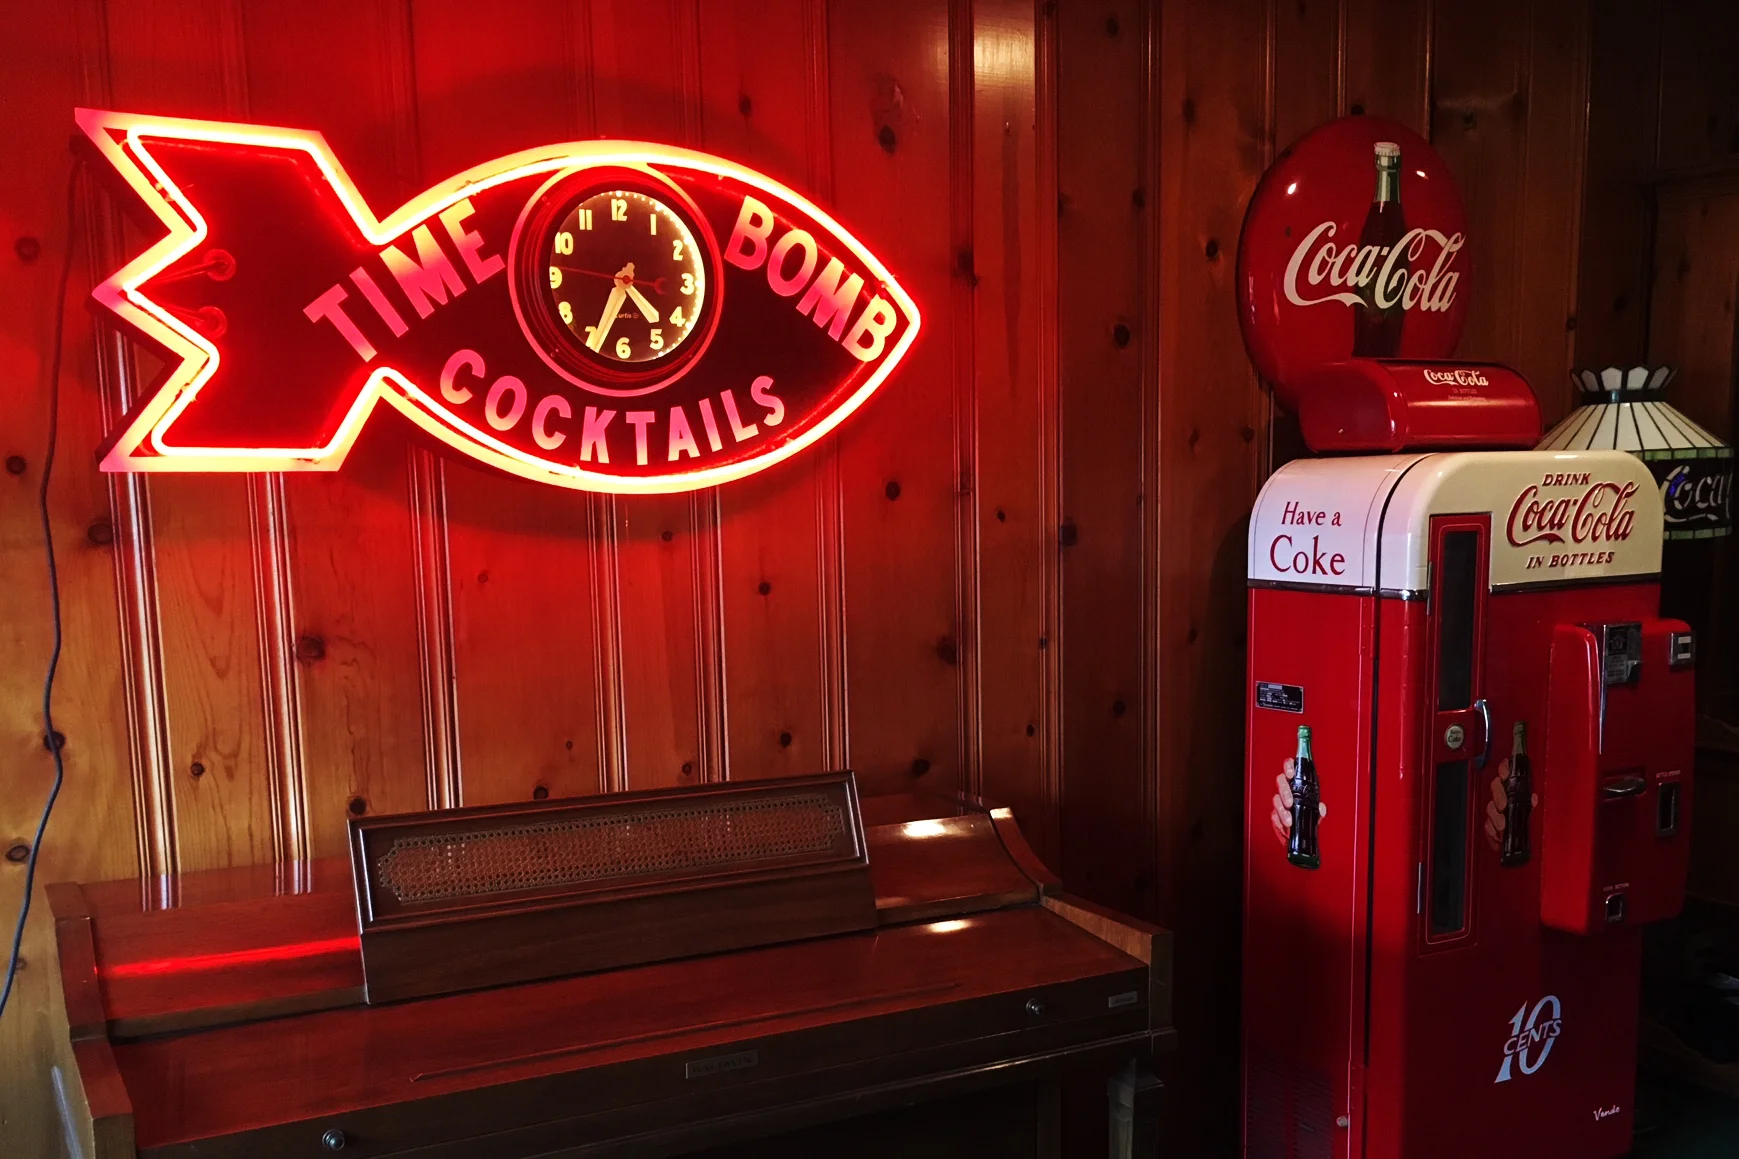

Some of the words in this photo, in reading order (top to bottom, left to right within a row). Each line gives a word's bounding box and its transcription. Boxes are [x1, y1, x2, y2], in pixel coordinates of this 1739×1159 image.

[578, 208, 593, 231] 11
[611, 198, 628, 221] 12
[650, 213, 657, 236] 1
[554, 231, 574, 255] 10
[672, 239, 683, 261] 2
[549, 266, 563, 289] 9
[1283, 220, 1467, 313] Coca-Cola
[304, 199, 507, 363] TIME
[724, 194, 898, 362] BOMB
[680, 272, 695, 295] 3
[558, 301, 574, 325] 8
[669, 306, 686, 327] 4
[615, 336, 632, 360] 6
[649, 328, 664, 350] 5
[1423, 368, 1489, 386] Coca-Cola
[439, 349, 787, 466] COCKTAILS
[1541, 472, 1592, 487] DRINK
[1281, 501, 1327, 527] Have
[1330, 511, 1343, 527] a
[1506, 481, 1641, 547] Coca-Cola
[1269, 534, 1346, 576] Coke
[1526, 554, 1545, 569] IN
[1548, 549, 1616, 567] BOTTLES
[1493, 994, 1561, 1084] 10
[1503, 1019, 1563, 1055] CENTS
